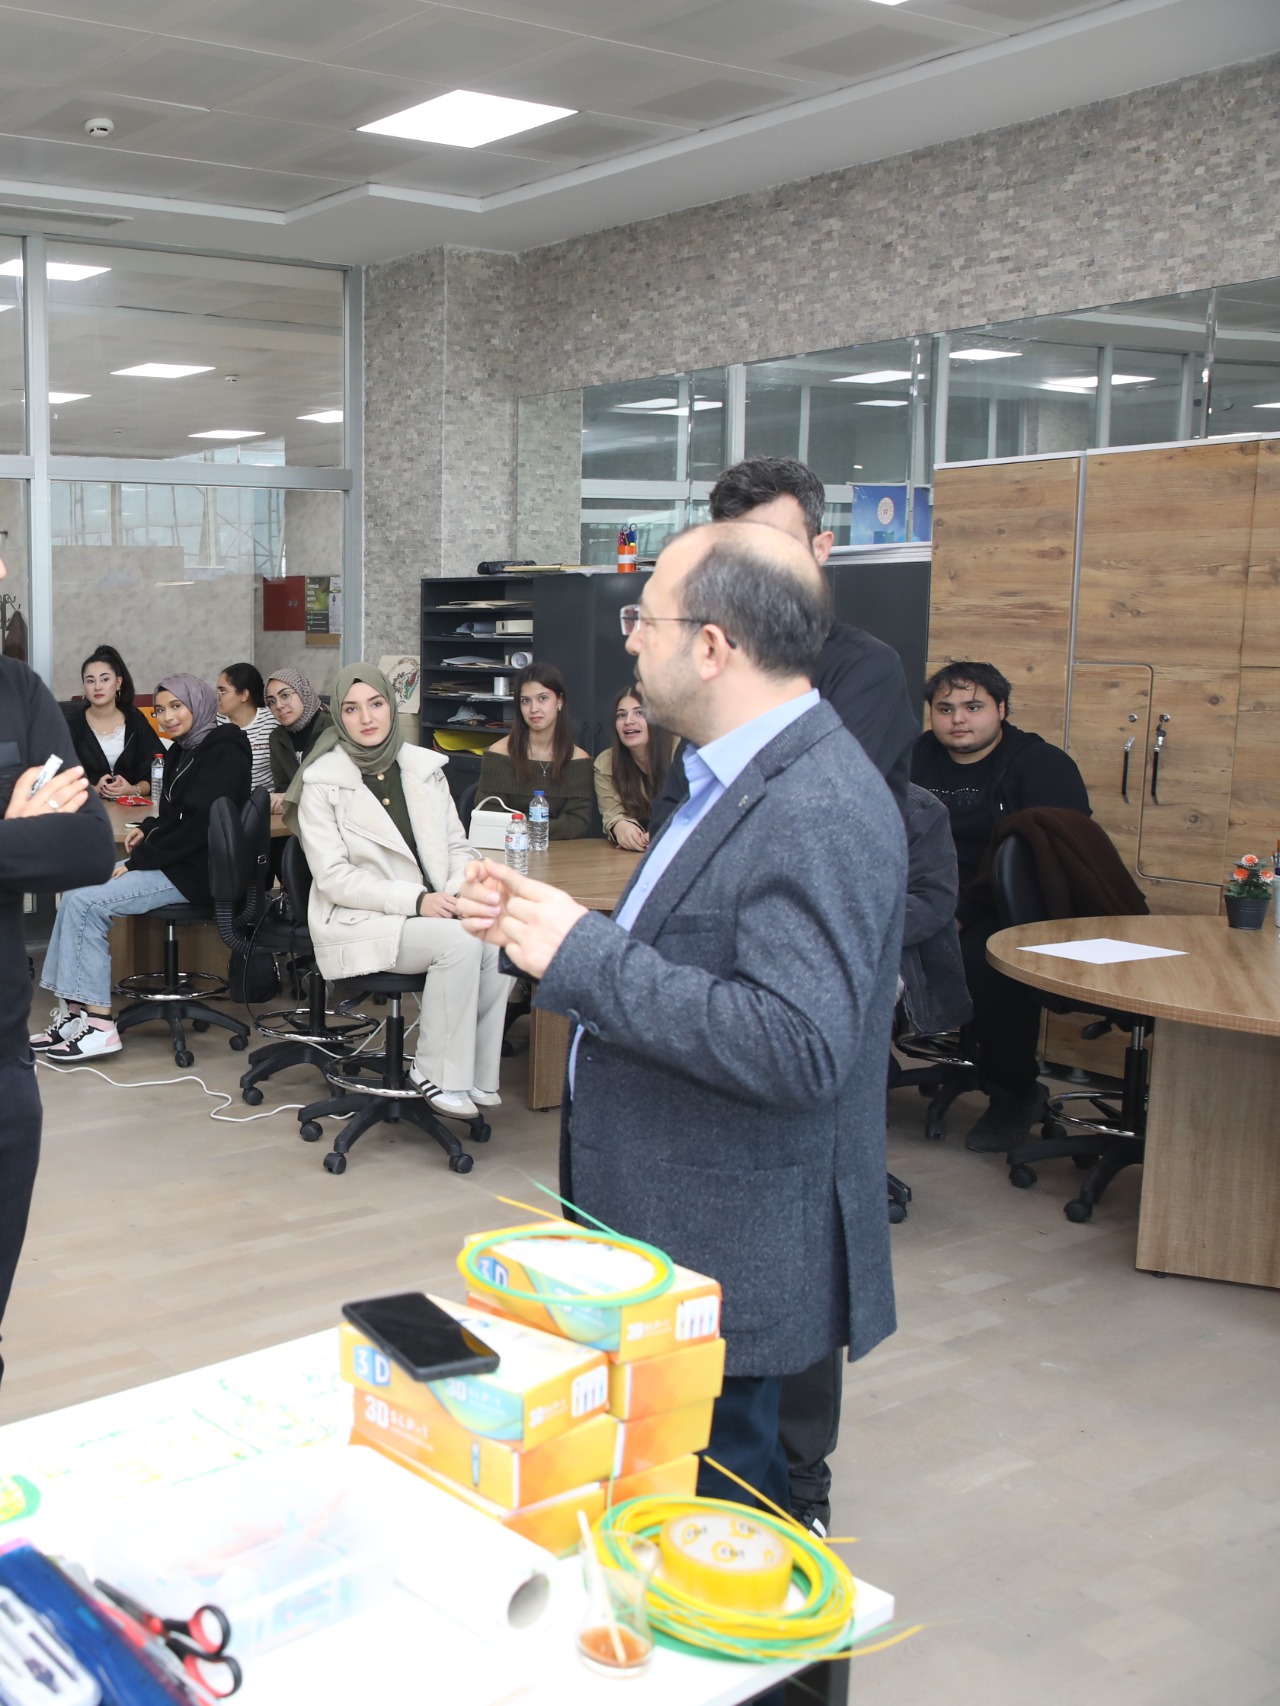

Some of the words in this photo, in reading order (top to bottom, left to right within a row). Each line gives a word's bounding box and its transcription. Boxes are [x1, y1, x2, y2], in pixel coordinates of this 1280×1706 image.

[357, 1349, 391, 1383] 3D
[446, 1378, 468, 1402] 3D
[365, 1394, 390, 1430] 3D
